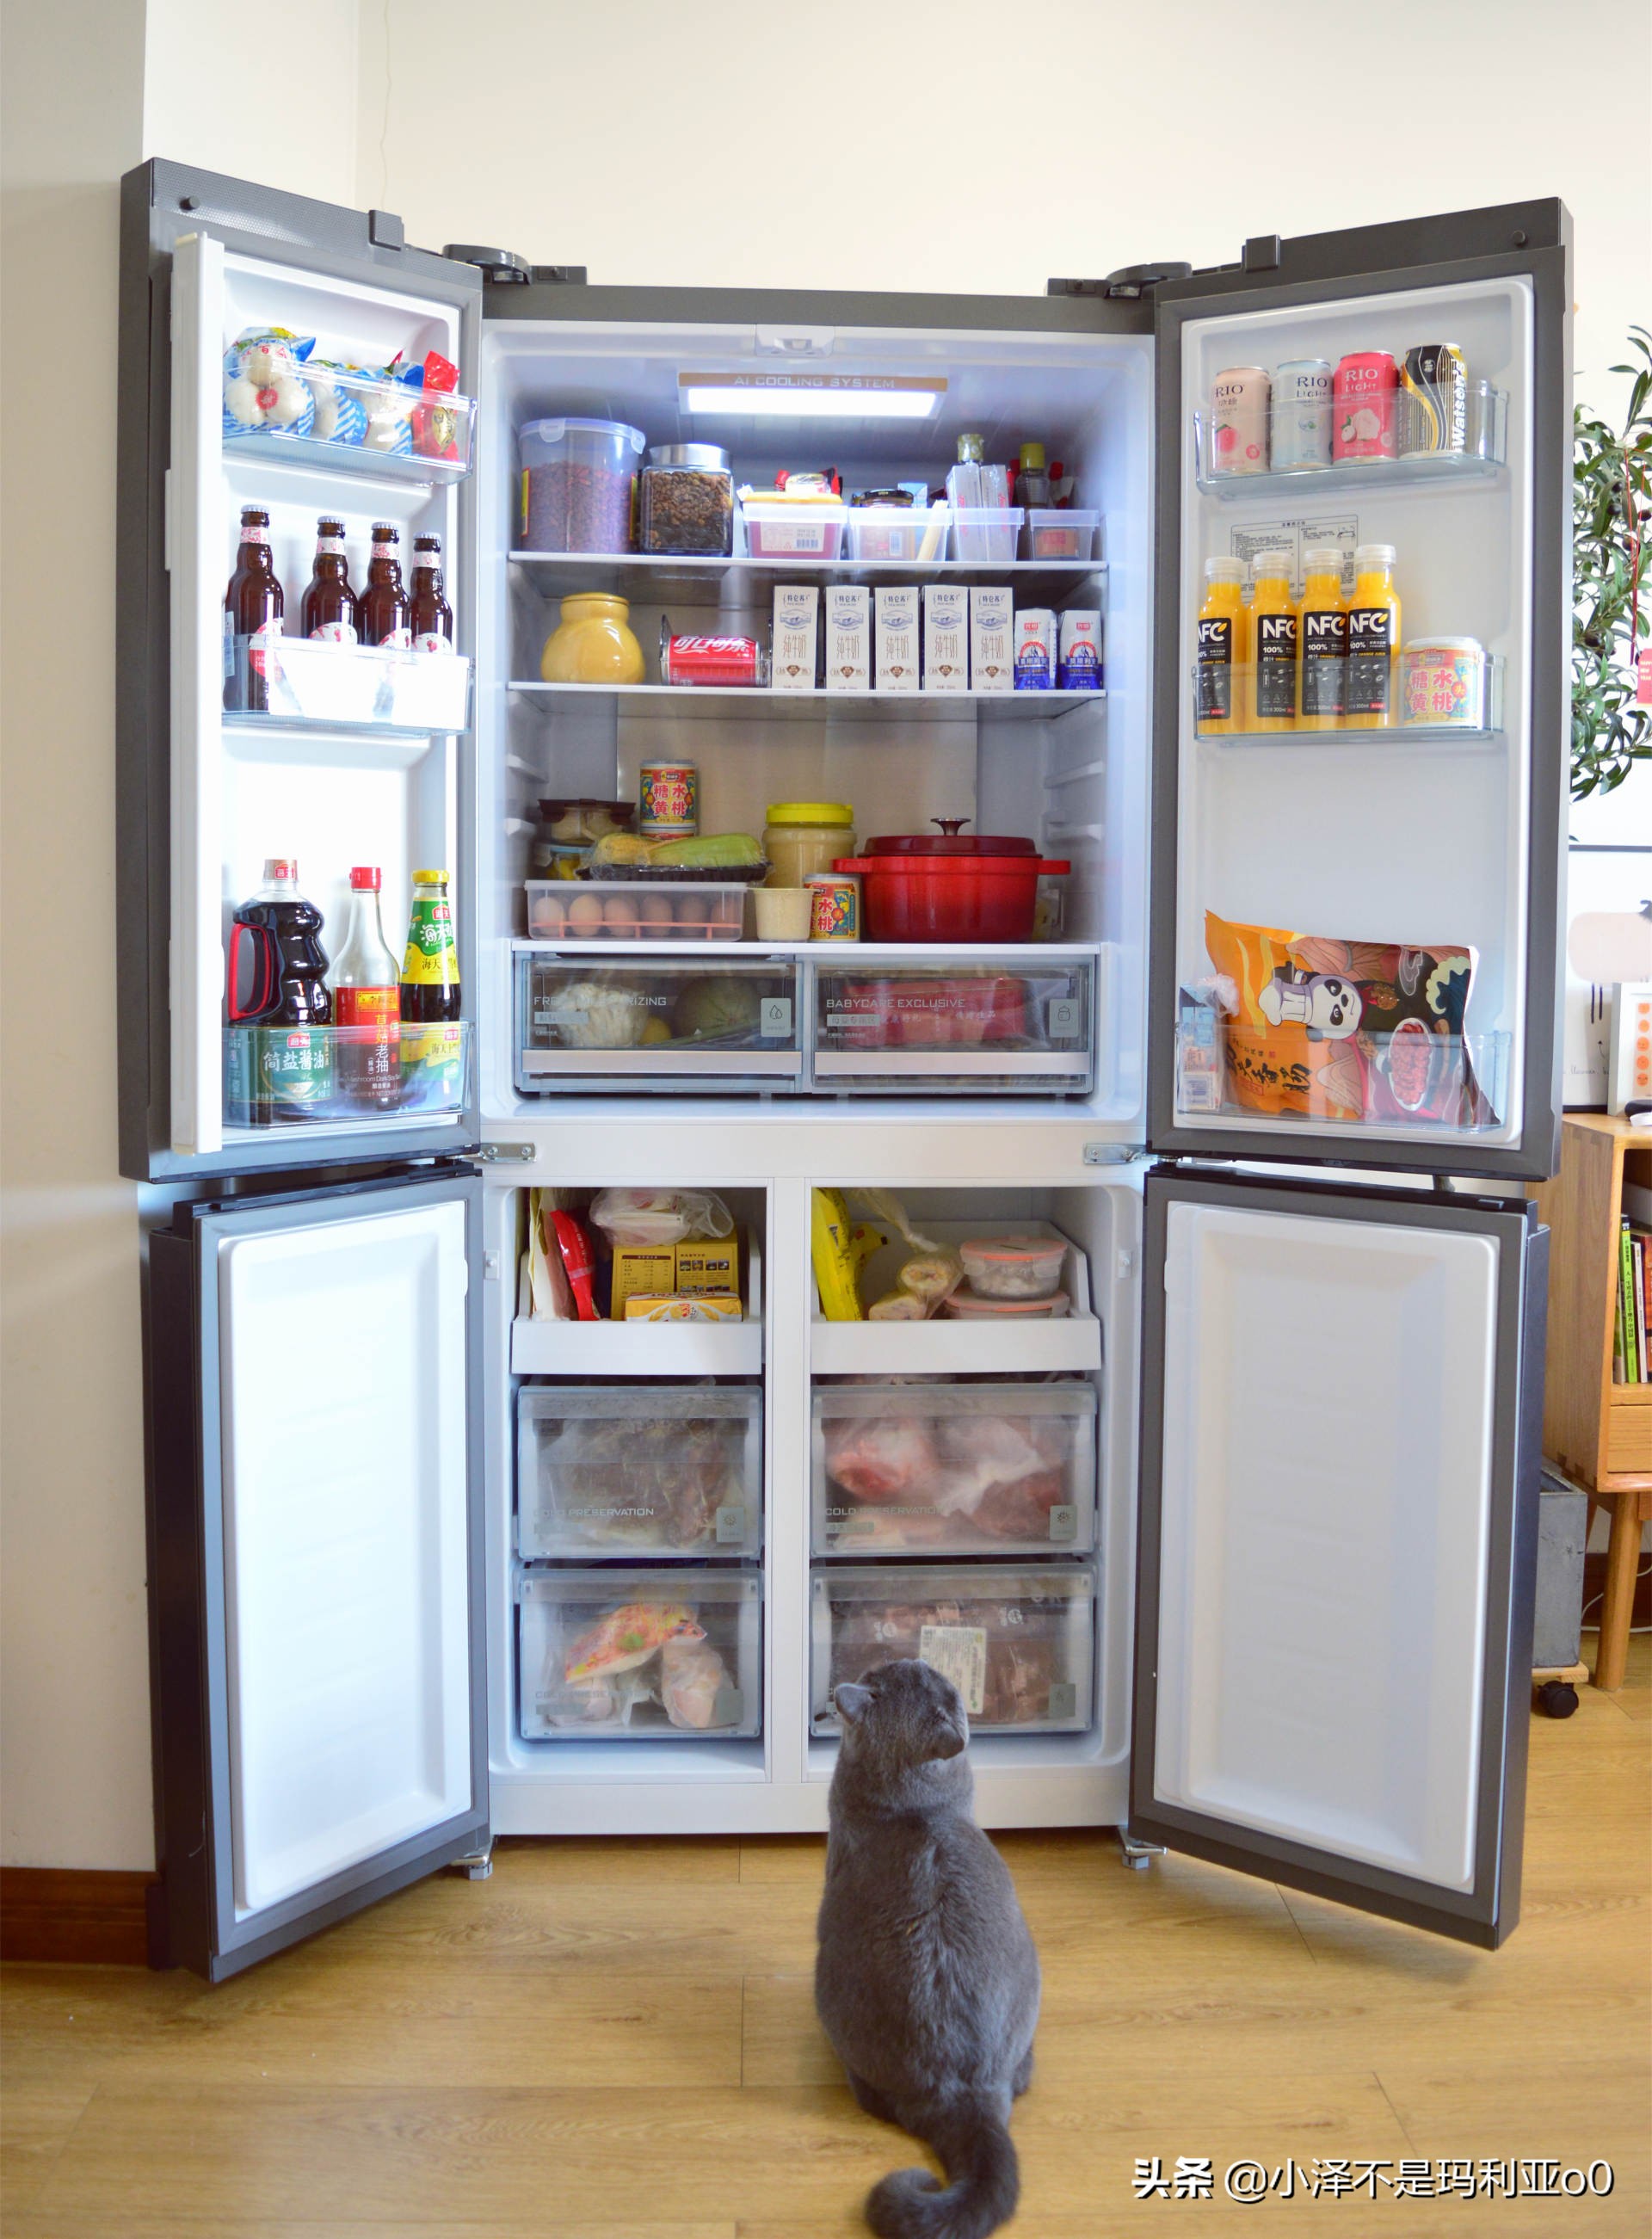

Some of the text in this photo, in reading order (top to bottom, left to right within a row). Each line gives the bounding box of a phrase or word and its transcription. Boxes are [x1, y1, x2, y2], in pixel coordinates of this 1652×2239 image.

[1346, 368, 1378, 381] RIO
[734, 377, 896, 388] AI COOLING SYSTEM
[1297, 376, 1328, 388] RIO
[1216, 385, 1244, 398] RIO
[1451, 358, 1465, 447] Watson's
[1308, 615, 1344, 636] NFC
[1411, 669, 1453, 689] 糖水
[1411, 692, 1453, 713] 黄桃
[654, 784, 686, 799] 糖水
[654, 800, 686, 816] 黄桃
[897, 999, 965, 1008] EXCLUSIVE
[826, 1508, 857, 1516] COLD
